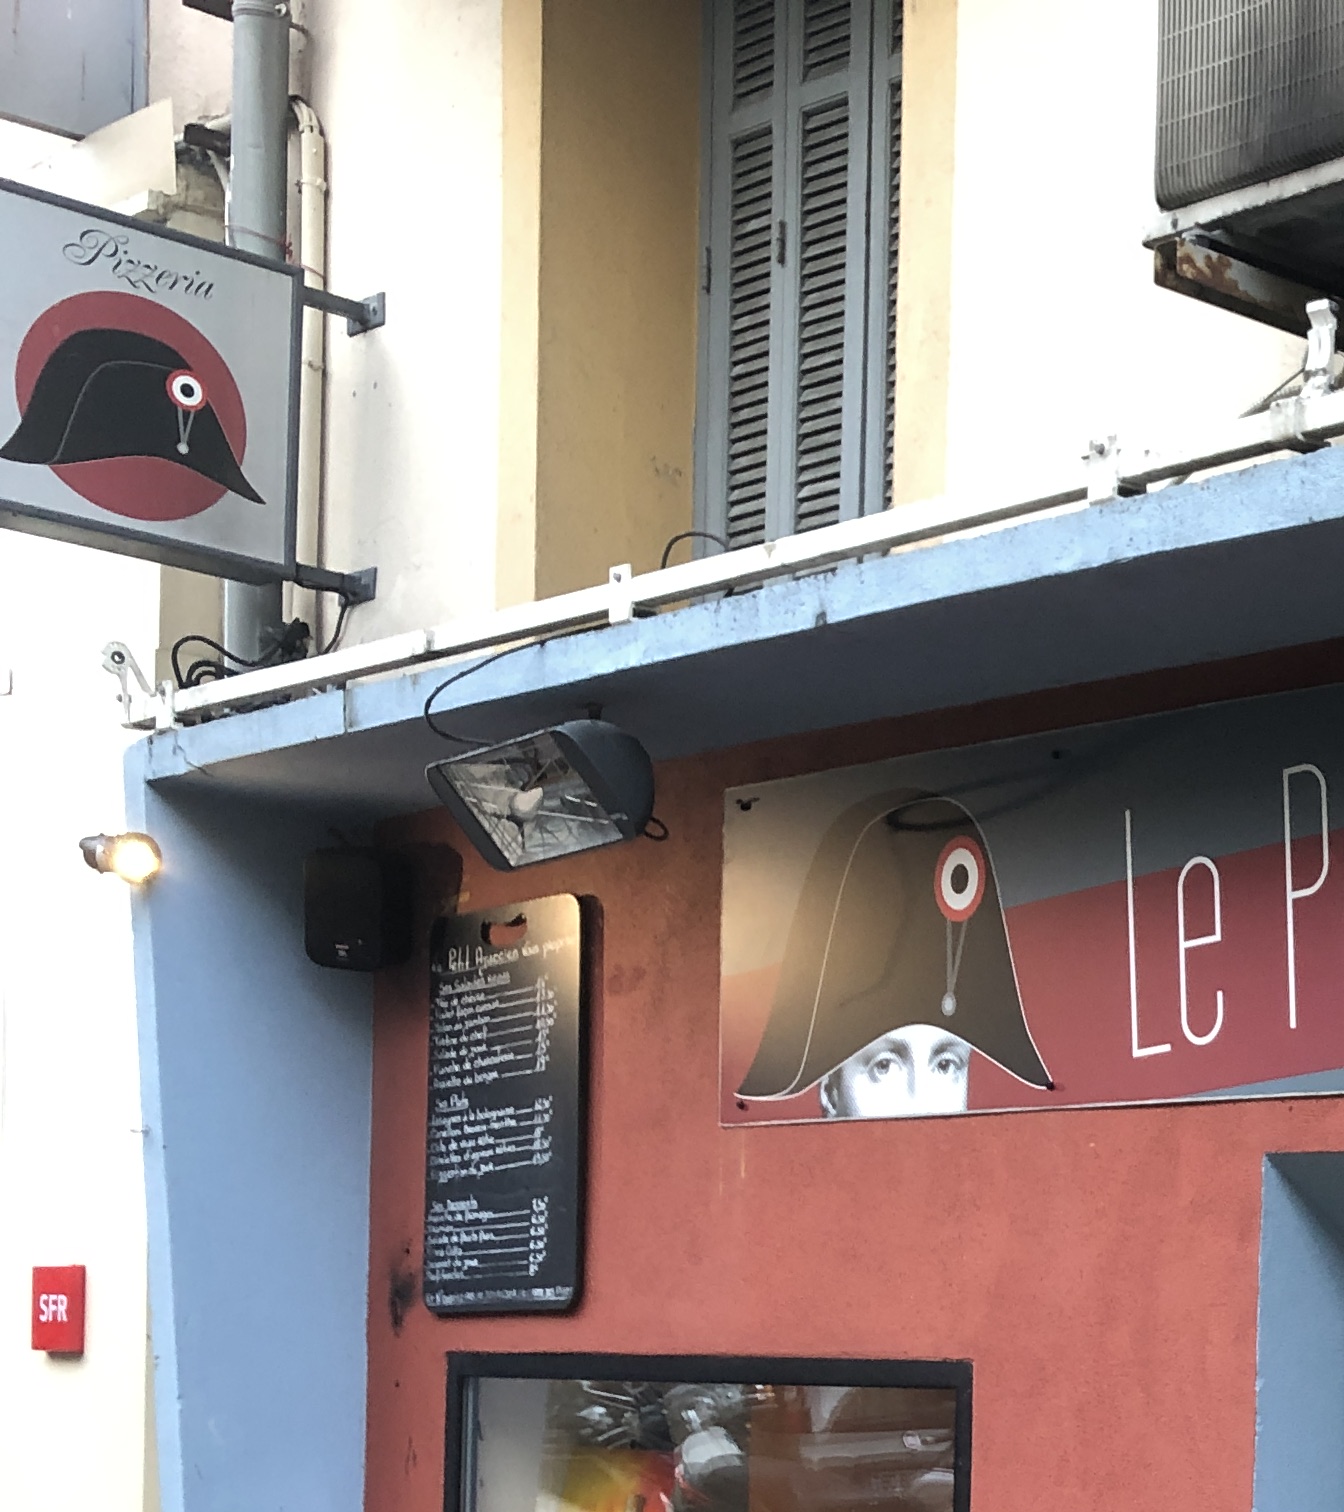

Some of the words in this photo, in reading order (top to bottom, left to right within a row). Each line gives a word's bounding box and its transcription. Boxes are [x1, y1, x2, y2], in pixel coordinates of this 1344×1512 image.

[62, 228, 214, 300] Pizzeria
[1124, 808, 1225, 1059] Le
[38, 1293, 69, 1323] SFR
